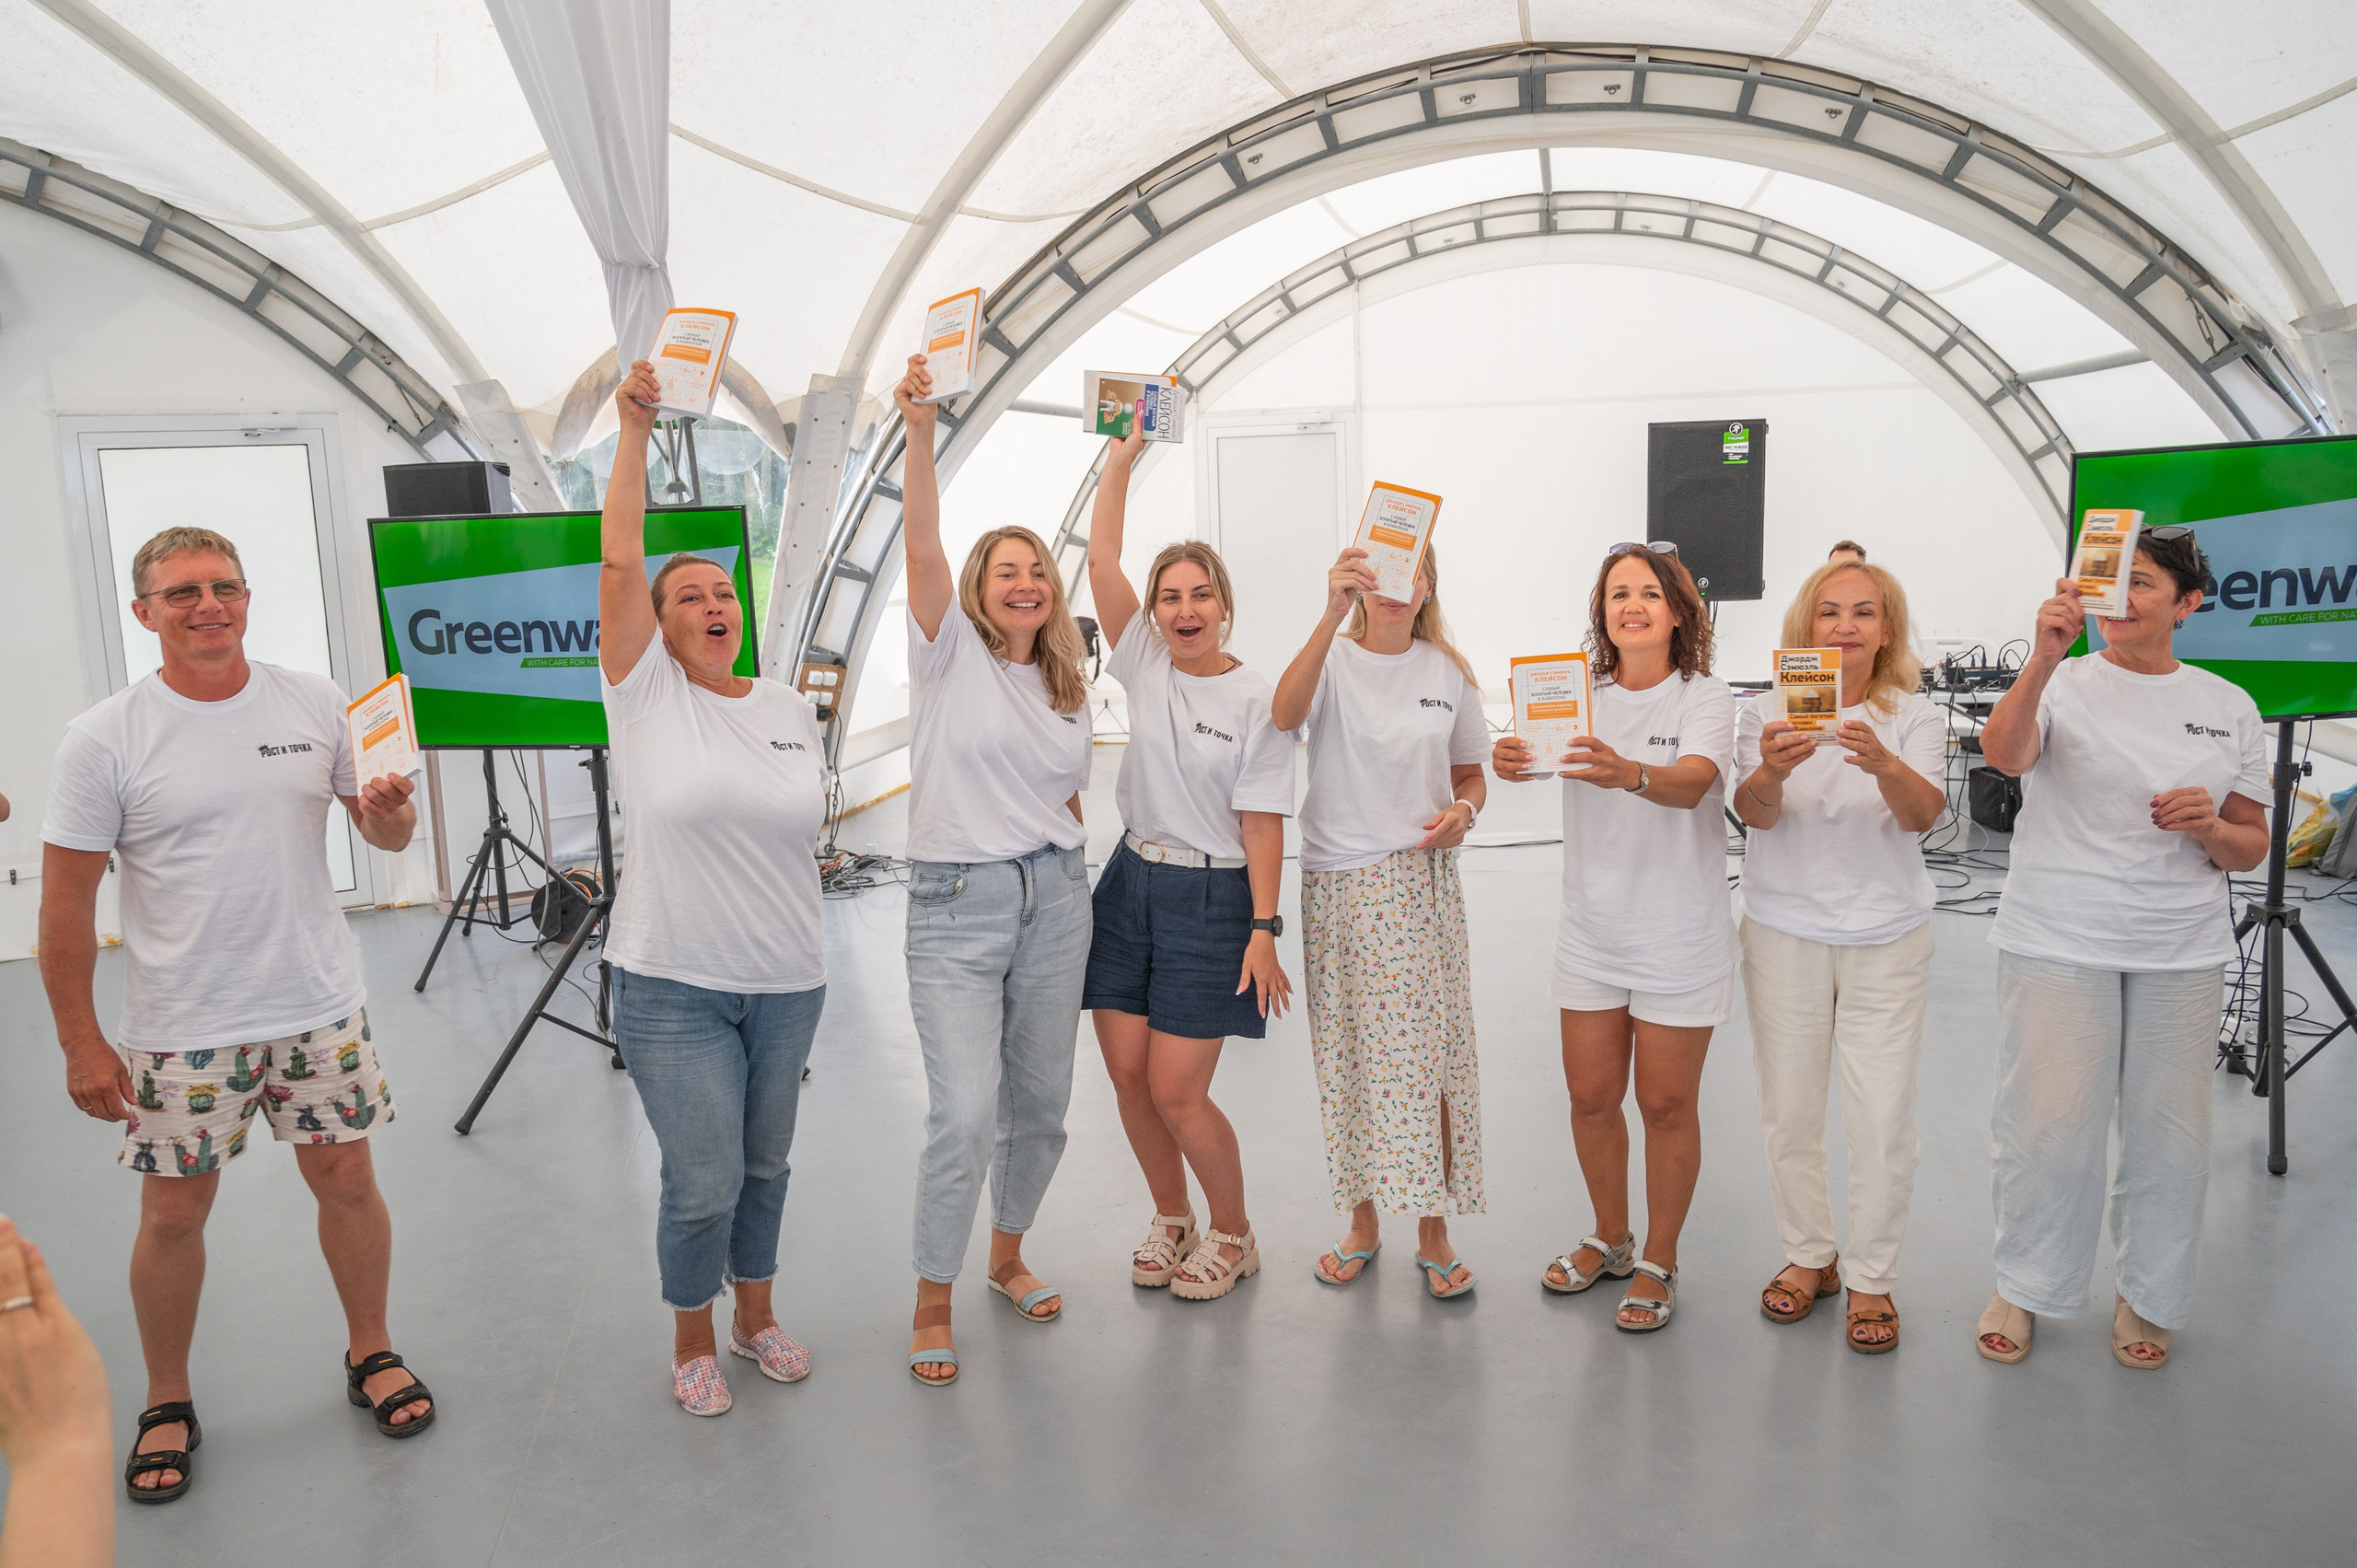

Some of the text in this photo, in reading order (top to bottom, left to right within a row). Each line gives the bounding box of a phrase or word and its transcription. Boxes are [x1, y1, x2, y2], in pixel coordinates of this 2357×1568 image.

[1158, 387, 1172, 439] КЛЕЙСОН
[1387, 504, 1417, 515] КЛЕЙСОН
[1387, 523, 1408, 532] ВАВИЛОНЕ
[2260, 616, 2286, 624] WITH
[2289, 613, 2315, 622] CARE
[2318, 612, 2338, 621] FOR
[408, 608, 600, 655] Greenw
[1781, 672, 1834, 683] Клейсон
[1213, 730, 1233, 743] ТОЧКА
[2186, 726, 2203, 735] РОСТ
[260, 743, 313, 758] РОСТ И ТОЧКА
